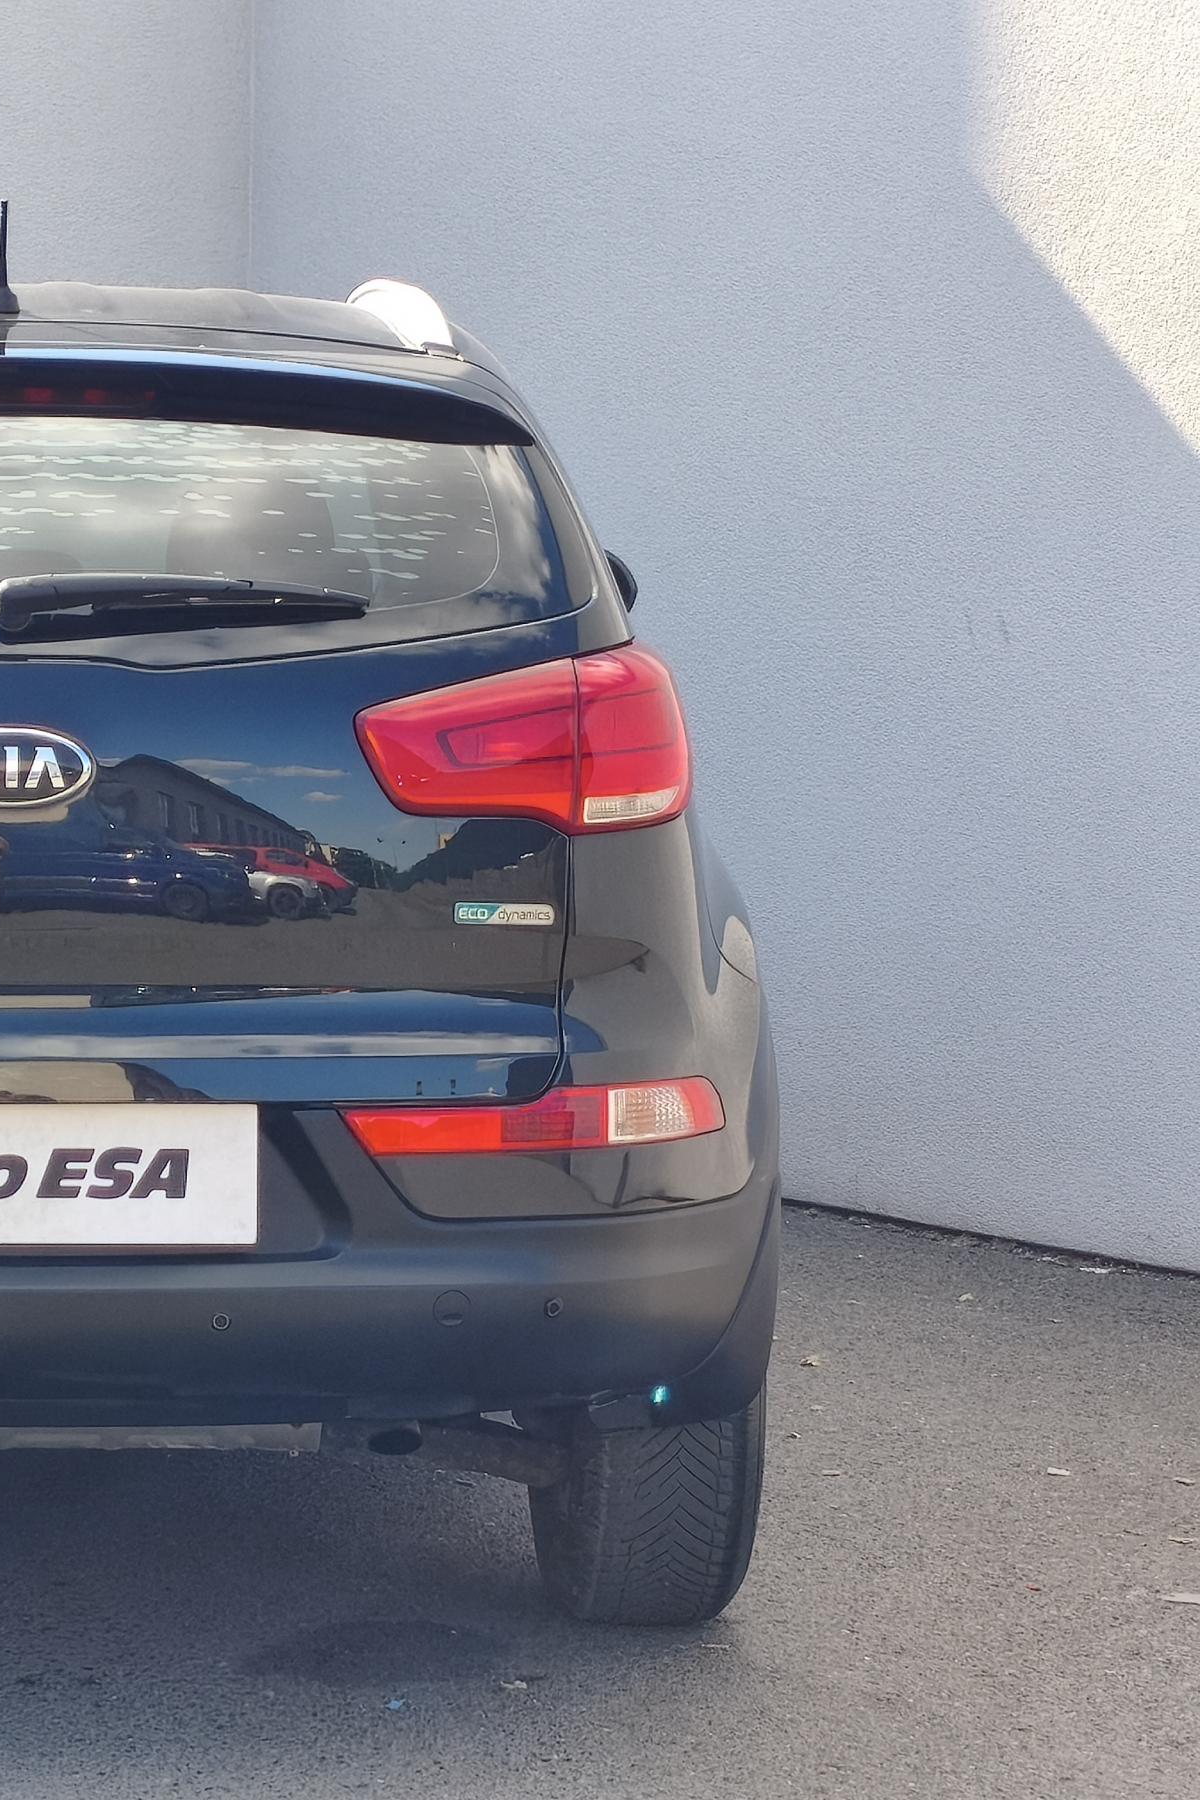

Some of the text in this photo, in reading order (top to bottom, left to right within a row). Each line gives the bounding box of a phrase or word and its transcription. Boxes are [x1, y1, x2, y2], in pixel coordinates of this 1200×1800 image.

[458, 907, 551, 922] ECO dynamics
[35, 1146, 189, 1199] ESA
